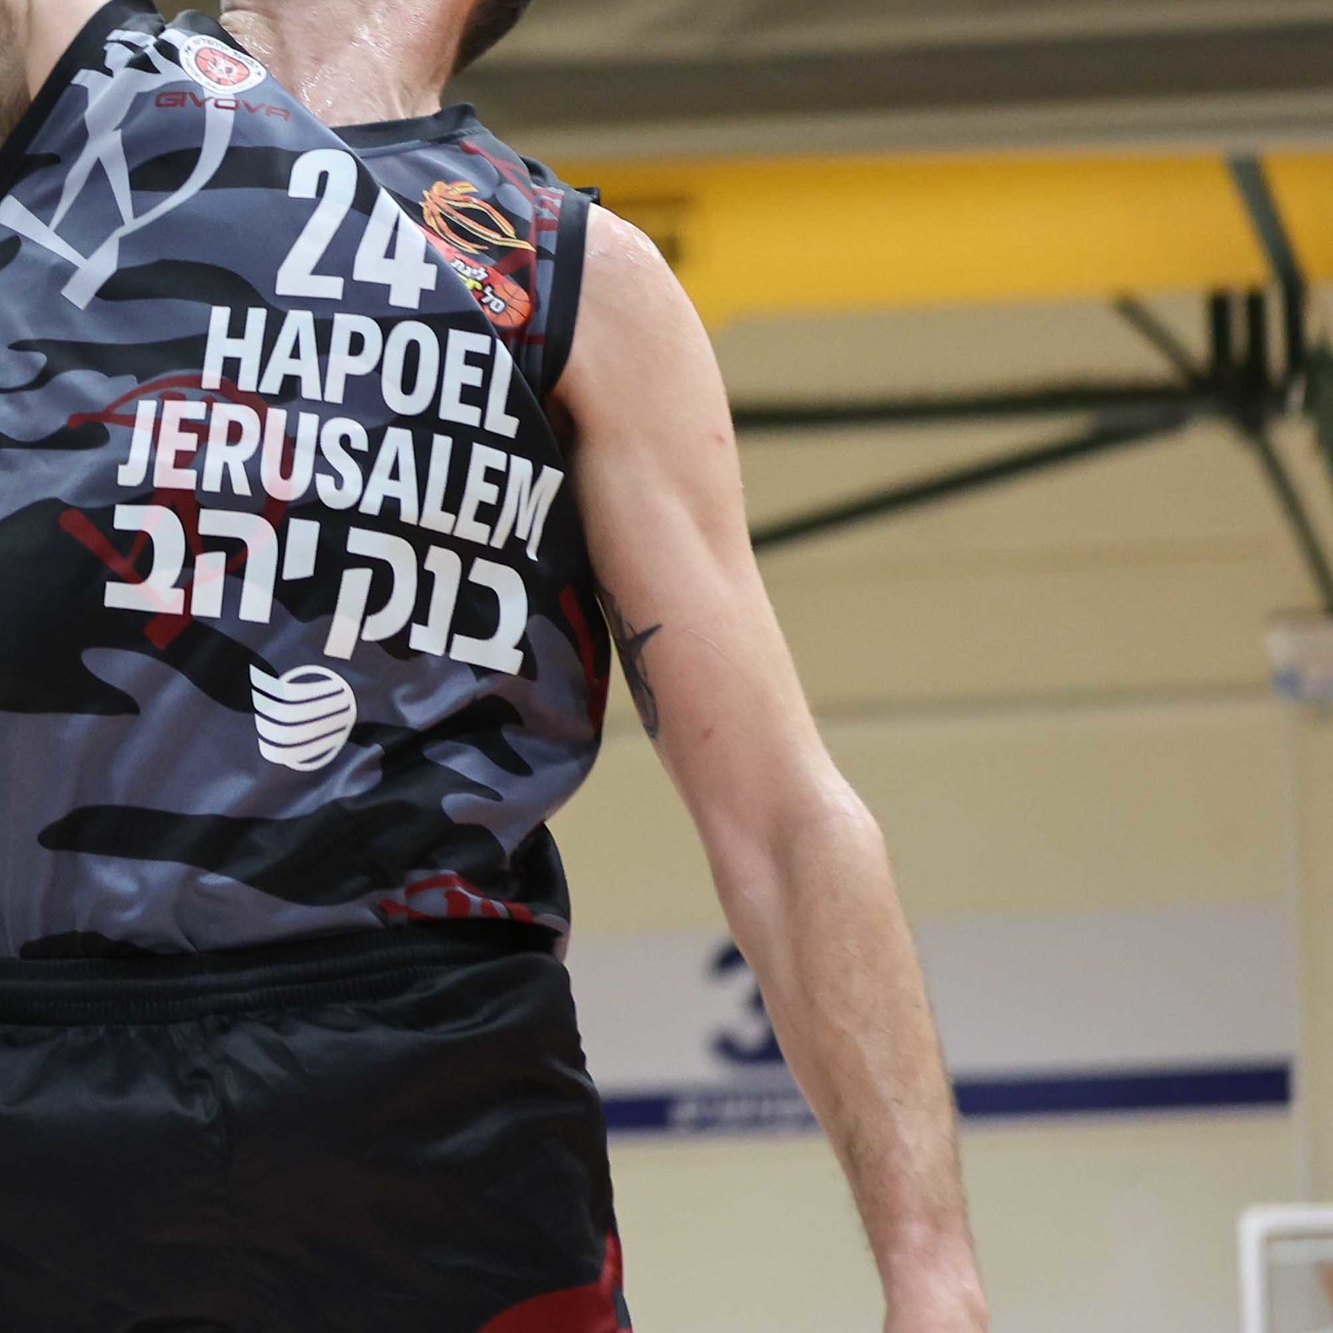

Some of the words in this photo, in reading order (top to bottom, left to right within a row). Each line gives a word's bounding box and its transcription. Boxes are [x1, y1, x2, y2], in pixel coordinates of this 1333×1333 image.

[155, 91, 291, 122] GIVOVA
[275, 148, 438, 310] 24
[201, 306, 520, 439] HAPOEL
[116, 399, 566, 562] JERUSALEM
[103, 503, 320, 623] יהב
[323, 531, 534, 676] בנק
